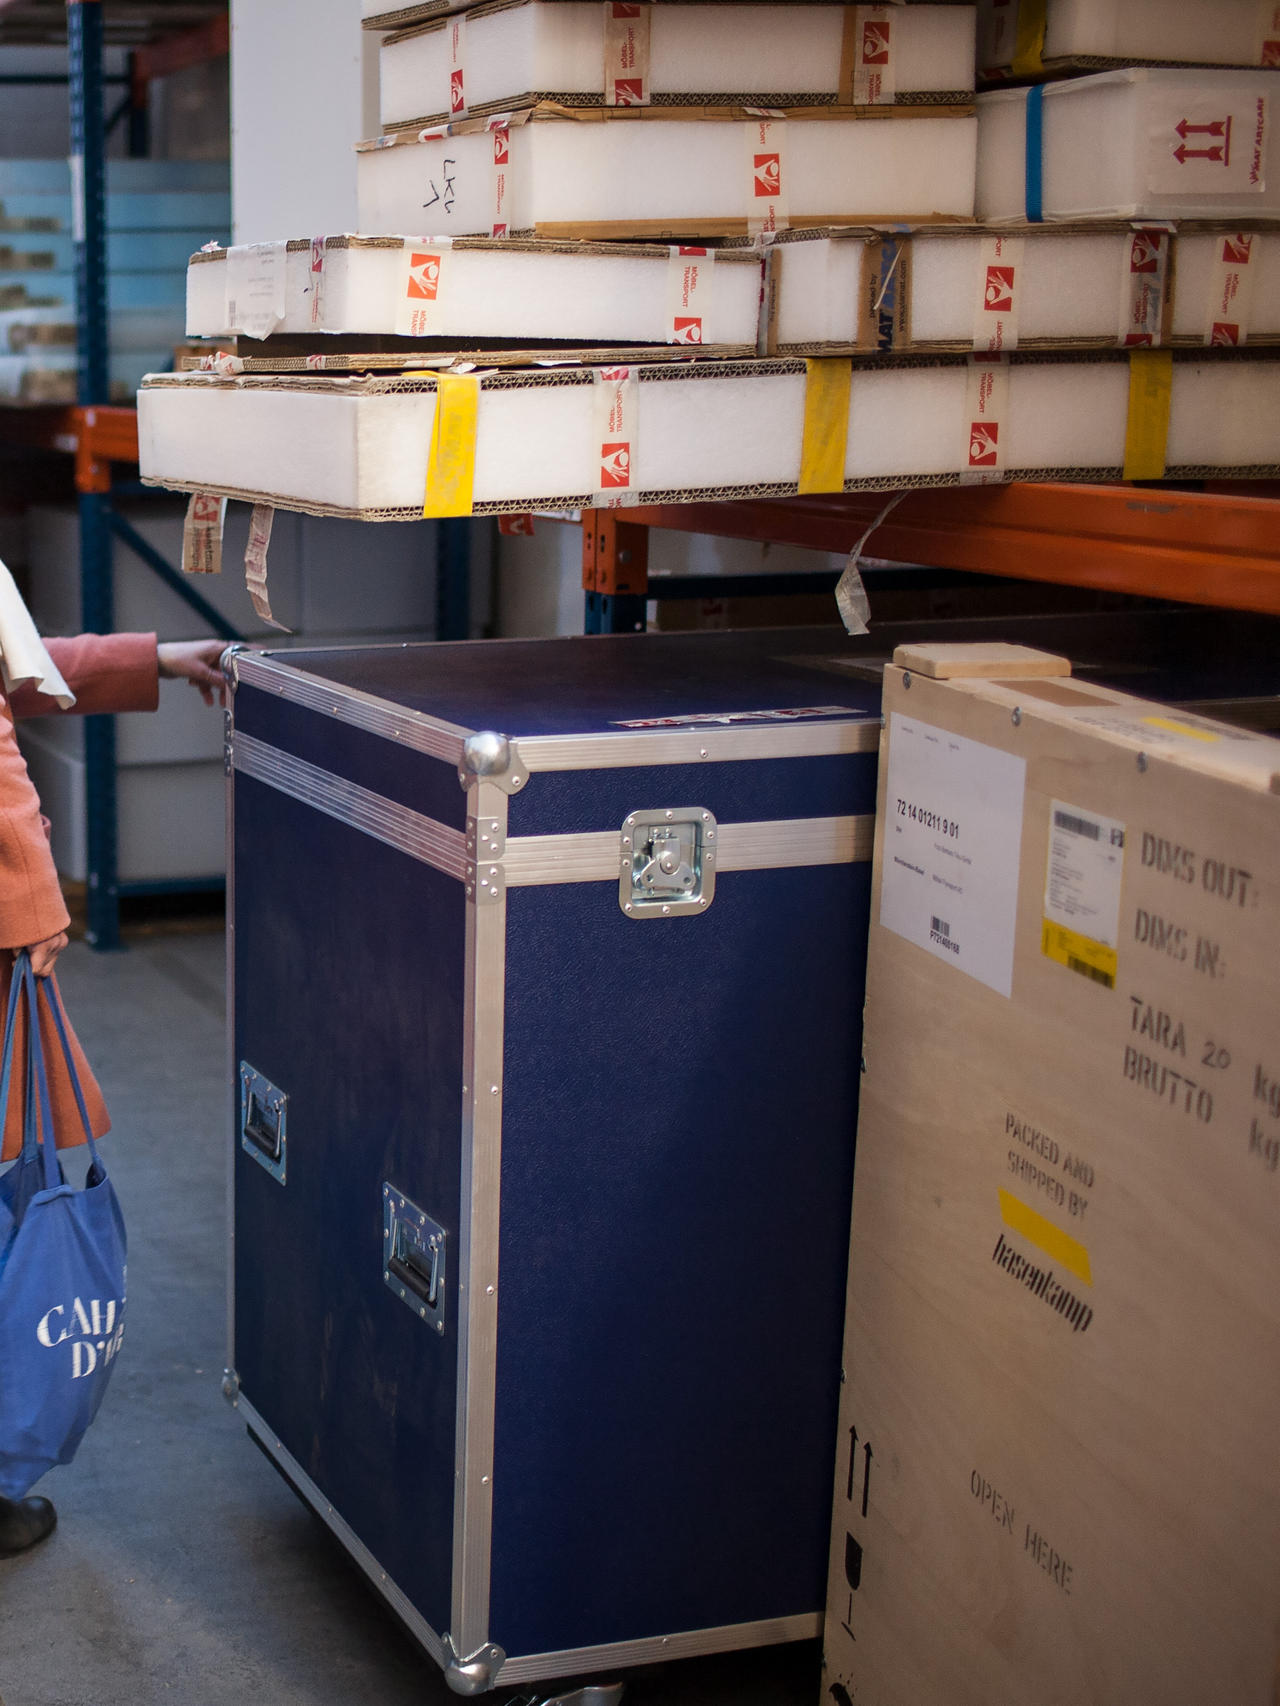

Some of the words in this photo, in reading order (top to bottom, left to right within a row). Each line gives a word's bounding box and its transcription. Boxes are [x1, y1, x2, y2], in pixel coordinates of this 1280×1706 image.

[897, 798, 906, 816] 72
[908, 803, 917, 821] 14
[918, 808, 941, 831] 01211
[942, 818, 948, 834] 9
[949, 822, 959, 839] 01
[1141, 831, 1195, 884] DIMS
[1135, 908, 1188, 962] DIMS
[1130, 995, 1186, 1058] TARA
[1123, 1044, 1213, 1124] BRUTTO
[1005, 1111, 1060, 1165] PACKED
[1063, 1155, 1095, 1188] AND
[1007, 1149, 1065, 1207] SHIPPED
[1068, 1189, 1088, 1223] BY
[992, 1233, 1094, 1333] hasenkamp
[970, 1469, 1015, 1535] OPEN
[1024, 1523, 1073, 1596] HERE
